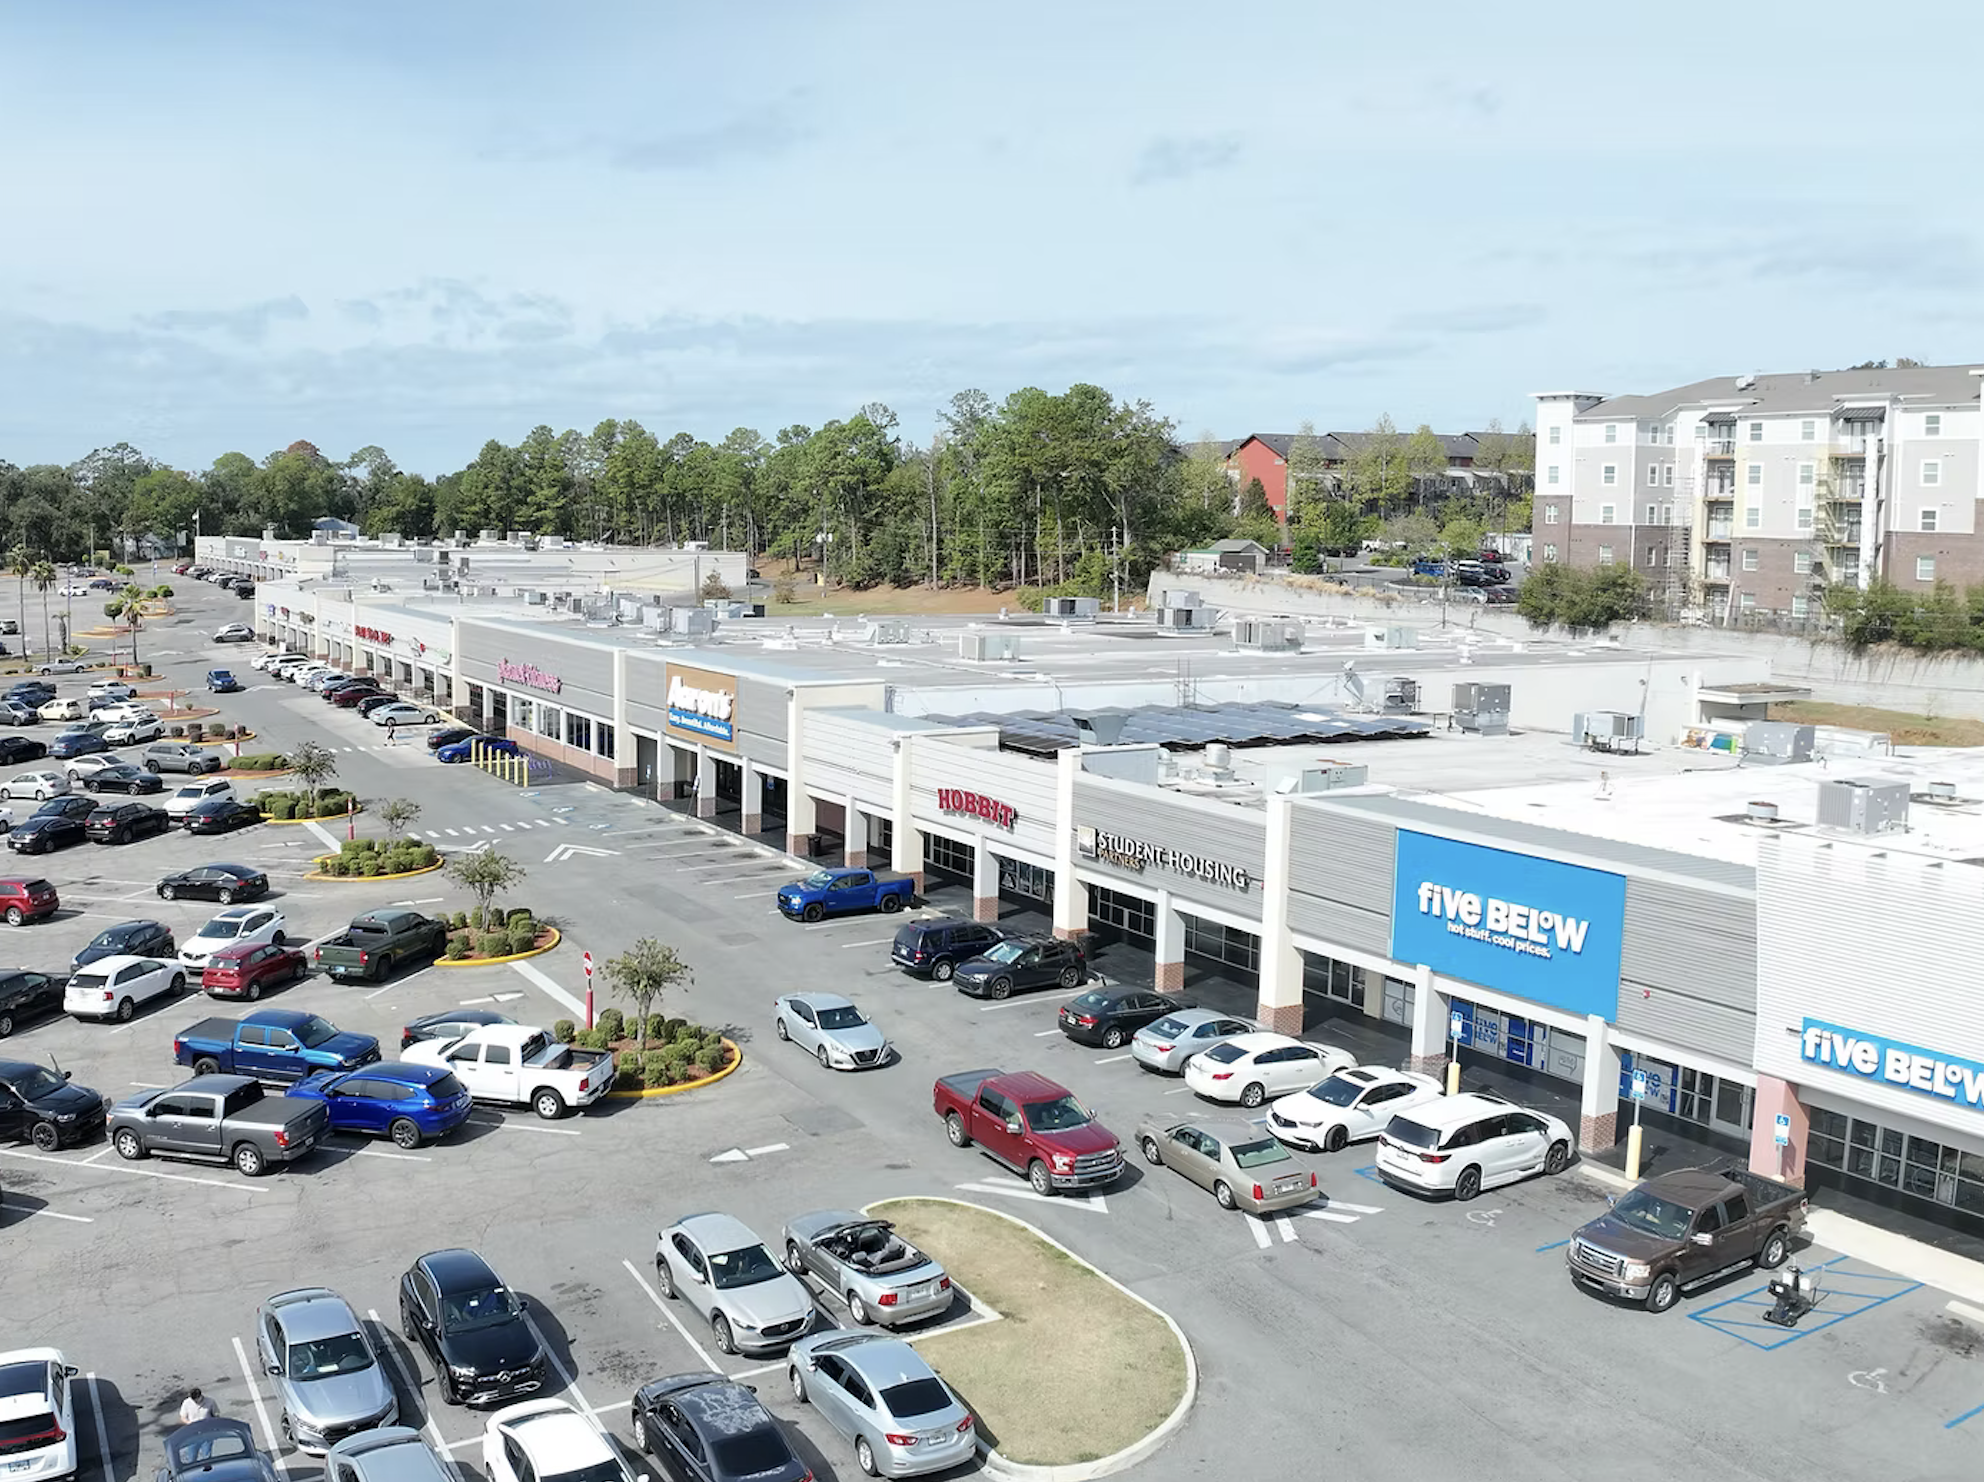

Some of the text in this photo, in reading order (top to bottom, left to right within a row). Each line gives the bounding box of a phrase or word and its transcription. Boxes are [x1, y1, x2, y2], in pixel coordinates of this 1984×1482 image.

[937, 788, 1013, 828] HOBBIT
[1099, 831, 1245, 887] STUDENT HOUSING
[1099, 849, 1141, 870] PARTNERS
[1418, 881, 1590, 953] five BELOW
[1447, 921, 1465, 935] hot
[1465, 927, 1492, 943] stuff.
[1492, 933, 1515, 949] cool
[1803, 1027, 1880, 1075] five
